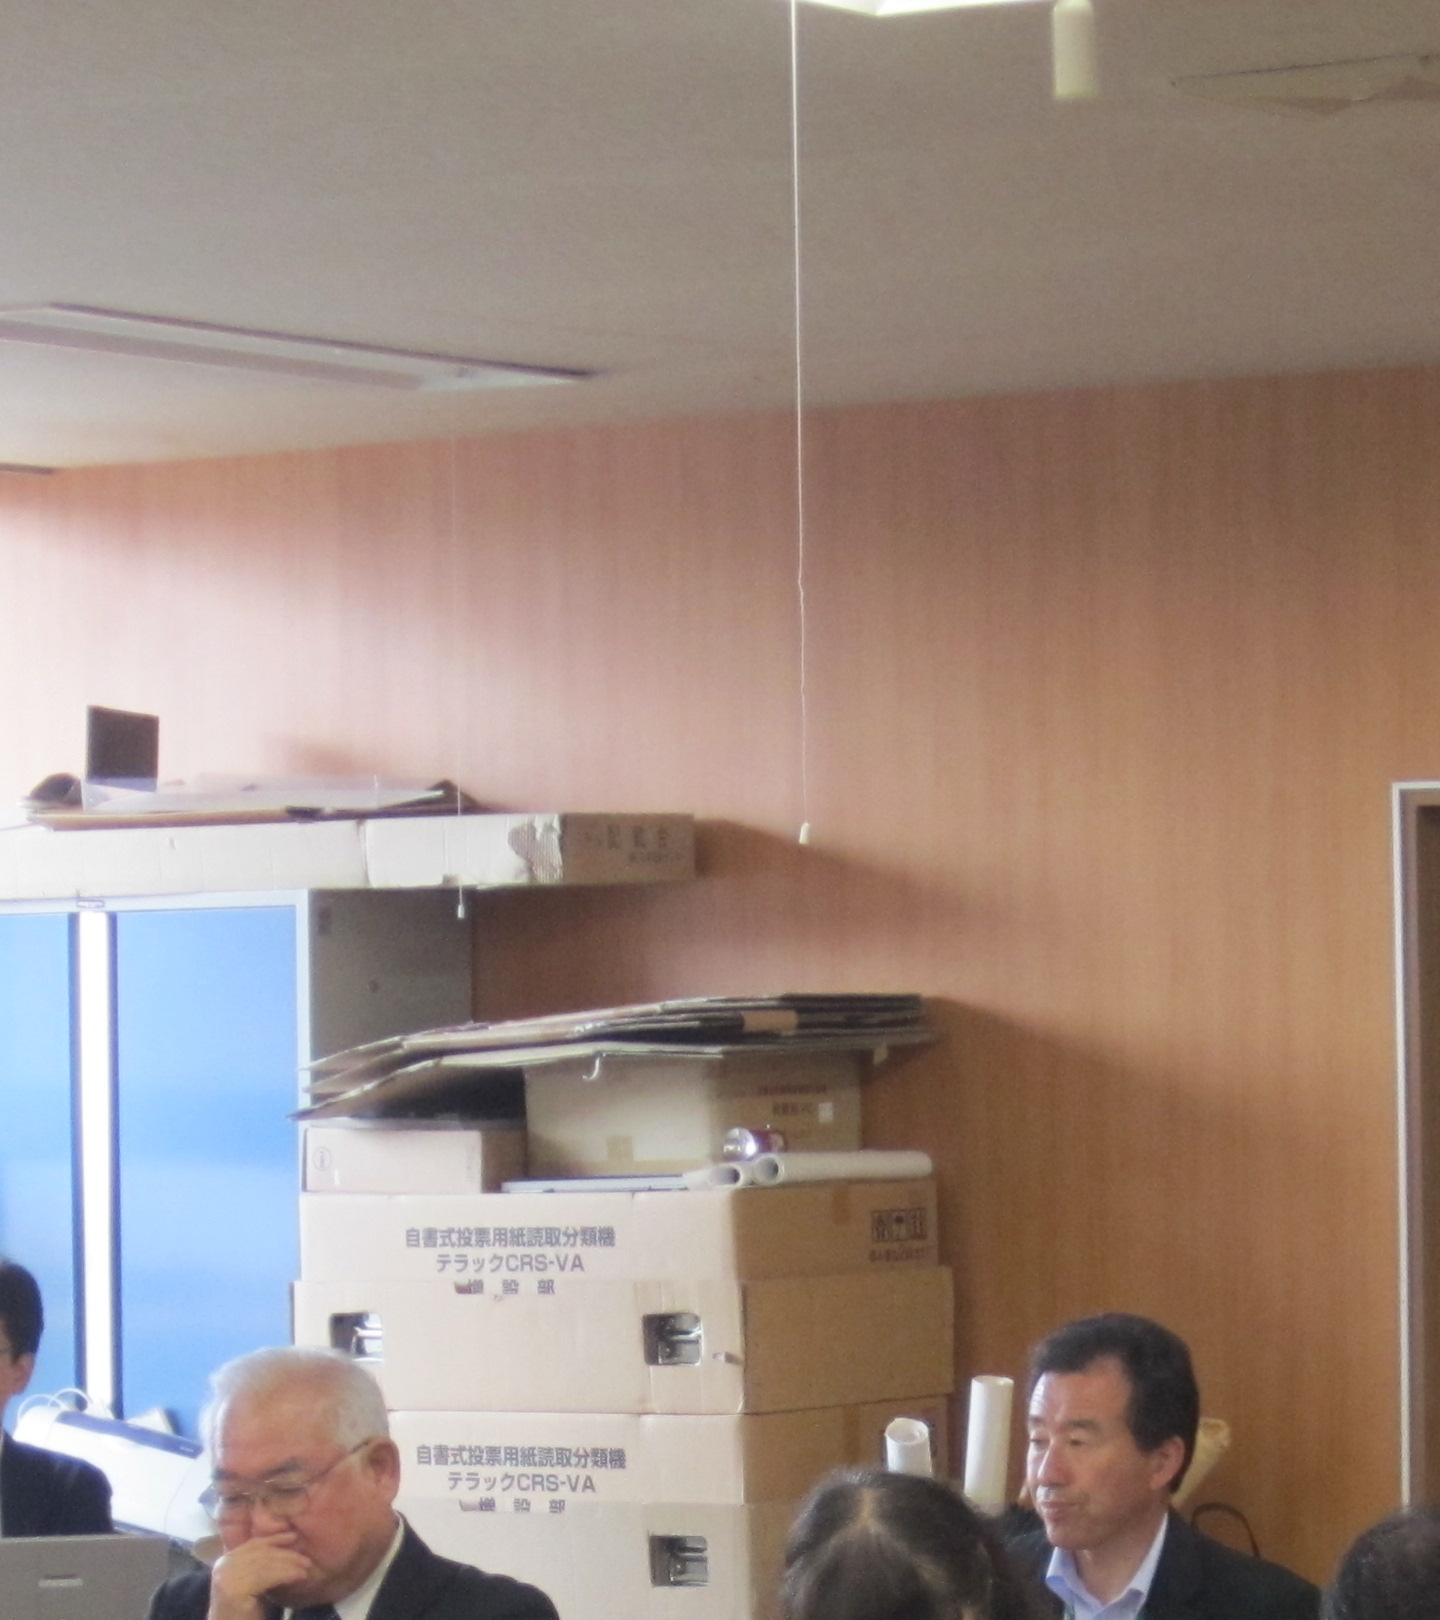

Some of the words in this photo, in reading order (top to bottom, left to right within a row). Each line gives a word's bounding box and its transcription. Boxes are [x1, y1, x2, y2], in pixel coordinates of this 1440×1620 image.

[405, 1226, 616, 1248] 自書式投票用紙読取分類機
[416, 1444, 627, 1469] 自書式投票用紙読取分類機
